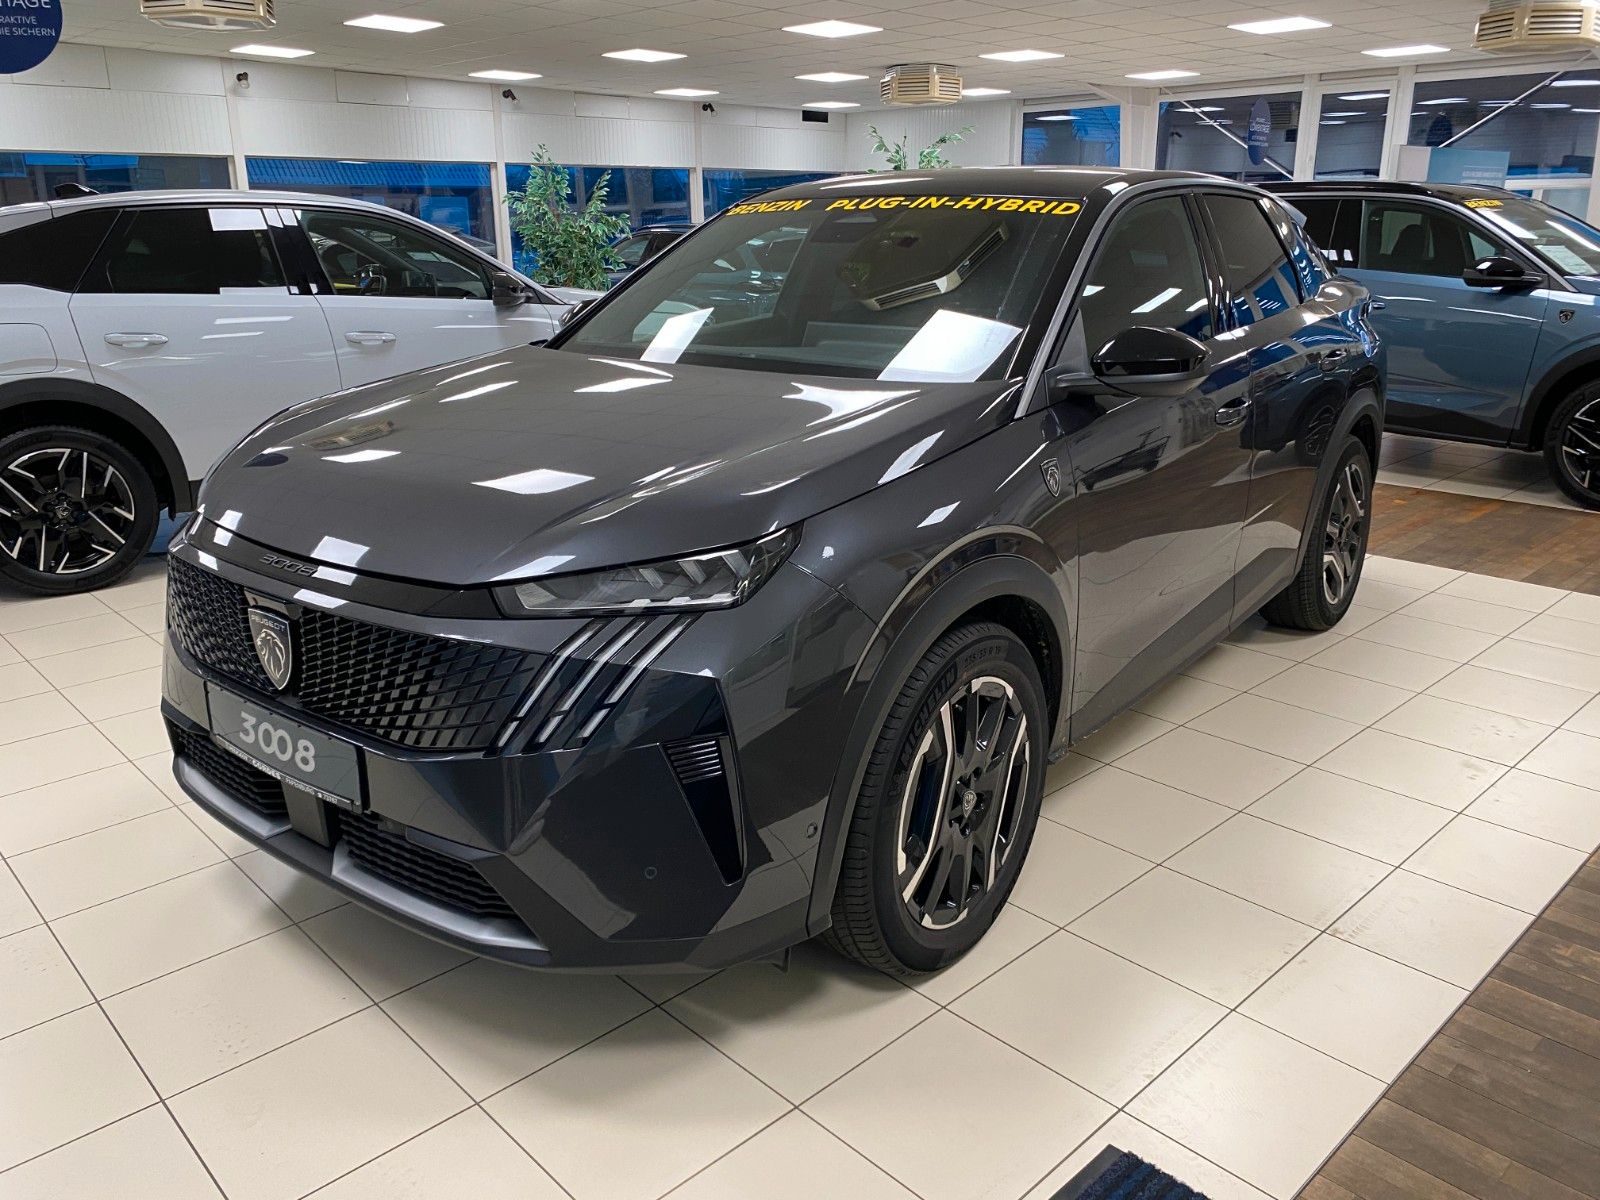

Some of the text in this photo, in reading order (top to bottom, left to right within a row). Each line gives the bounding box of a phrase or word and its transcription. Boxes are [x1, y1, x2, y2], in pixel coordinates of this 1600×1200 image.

[12, 27, 56, 36] SICHERN
[726, 196, 1081, 216] BENZIN PLUG-IN-HYBRID
[260, 553, 318, 577] 3008
[251, 614, 285, 632] PEUGEOT
[900, 662, 957, 768] MICHELIN
[239, 710, 316, 773] 3008
